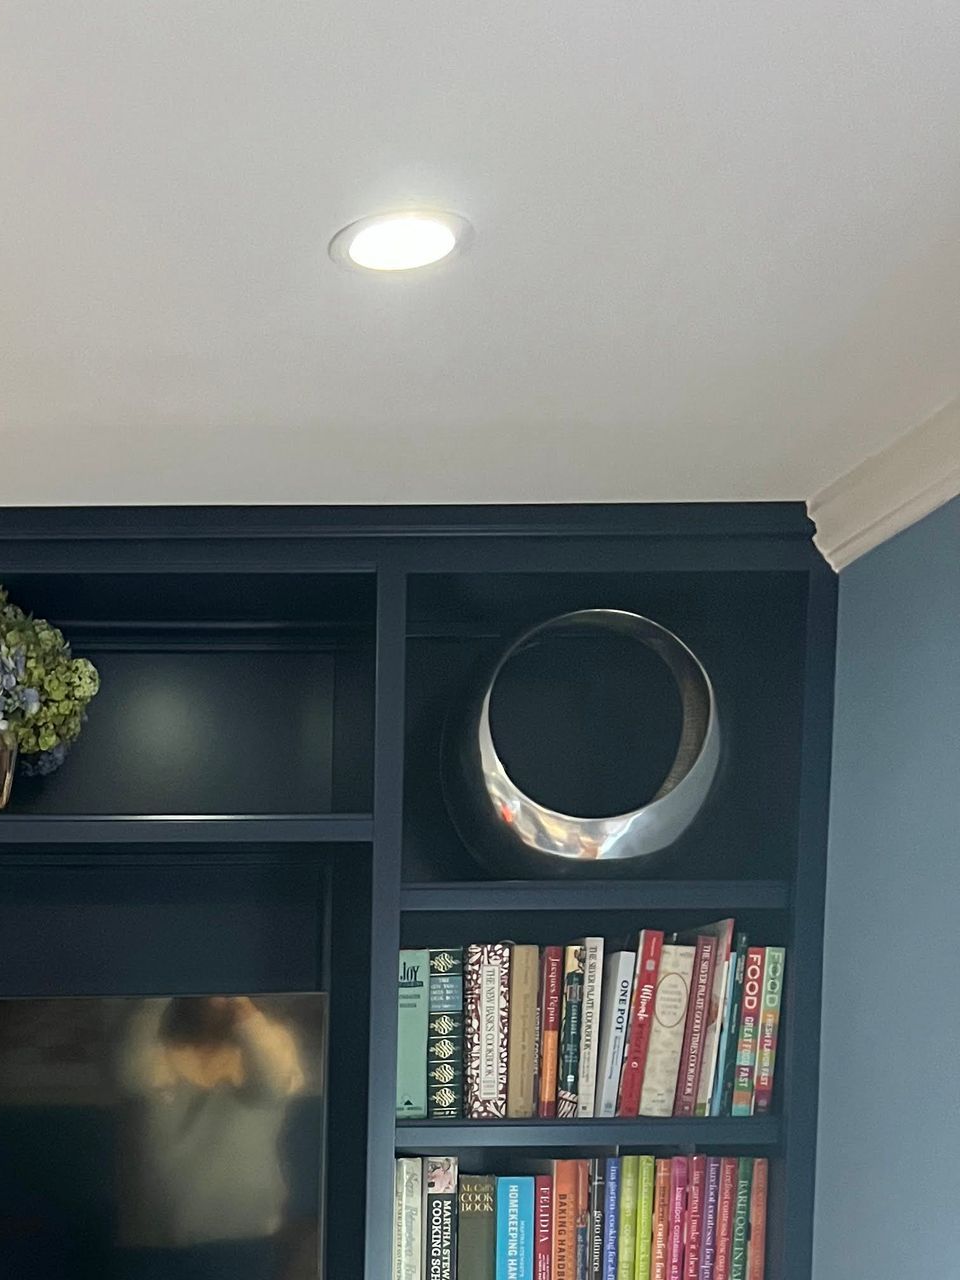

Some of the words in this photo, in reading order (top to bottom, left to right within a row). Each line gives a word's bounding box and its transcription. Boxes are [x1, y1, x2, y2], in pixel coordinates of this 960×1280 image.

[590, 946, 598, 959] THE
[702, 945, 711, 960] THE
[486, 969, 495, 984] THE
[549, 957, 560, 993] Jacques
[588, 962, 596, 984] SILVER
[698, 961, 709, 983] SILVER
[744, 954, 760, 1009] FOOD
[766, 952, 783, 1007] FOOD
[486, 986, 495, 1004] NEW
[587, 985, 595, 1010] PALATE
[619, 980, 628, 1005] ONE
[695, 985, 706, 1010] PALATE
[486, 1006, 495, 1032] BASICS
[616, 1008, 625, 1032] POT
[693, 1011, 703, 1031] GOOD
[742, 1017, 754, 1042] GREAT
[764, 1014, 774, 1038] FRESH
[690, 1033, 700, 1054] TIMES
[741, 1044, 751, 1065] FOOD
[762, 1040, 771, 1066] FLAVOR
[684, 1055, 697, 1094] COOKBOOK
[739, 1068, 749, 1087] FAST
[760, 1068, 769, 1086] FAST
[709, 1163, 719, 1202] barefoot
[724, 1165, 734, 1200] barefoot
[461, 1192, 493, 1202] COOK
[461, 1203, 493, 1212] BOOK
[608, 1181, 616, 1210] garten
[675, 1187, 684, 1223] barefoot
[442, 1200, 451, 1247] MARTHA
[507, 1185, 518, 1255] HOMEKEEPING
[558, 1194, 567, 1236] BAKING
[721, 1200, 730, 1236] contessa
[735, 1180, 748, 1242] BAREFOOT
[431, 1200, 441, 1256] COOKING
[607, 1215, 616, 1250] cooking
[705, 1205, 715, 1246] contessa
[593, 1235, 603, 1272] dinners
[656, 1223, 665, 1259] comfort
[672, 1225, 681, 1263] contessa
[608, 1251, 616, 1264] for
[689, 1252, 698, 1277] ahead
[734, 1248, 744, 1260] IN
